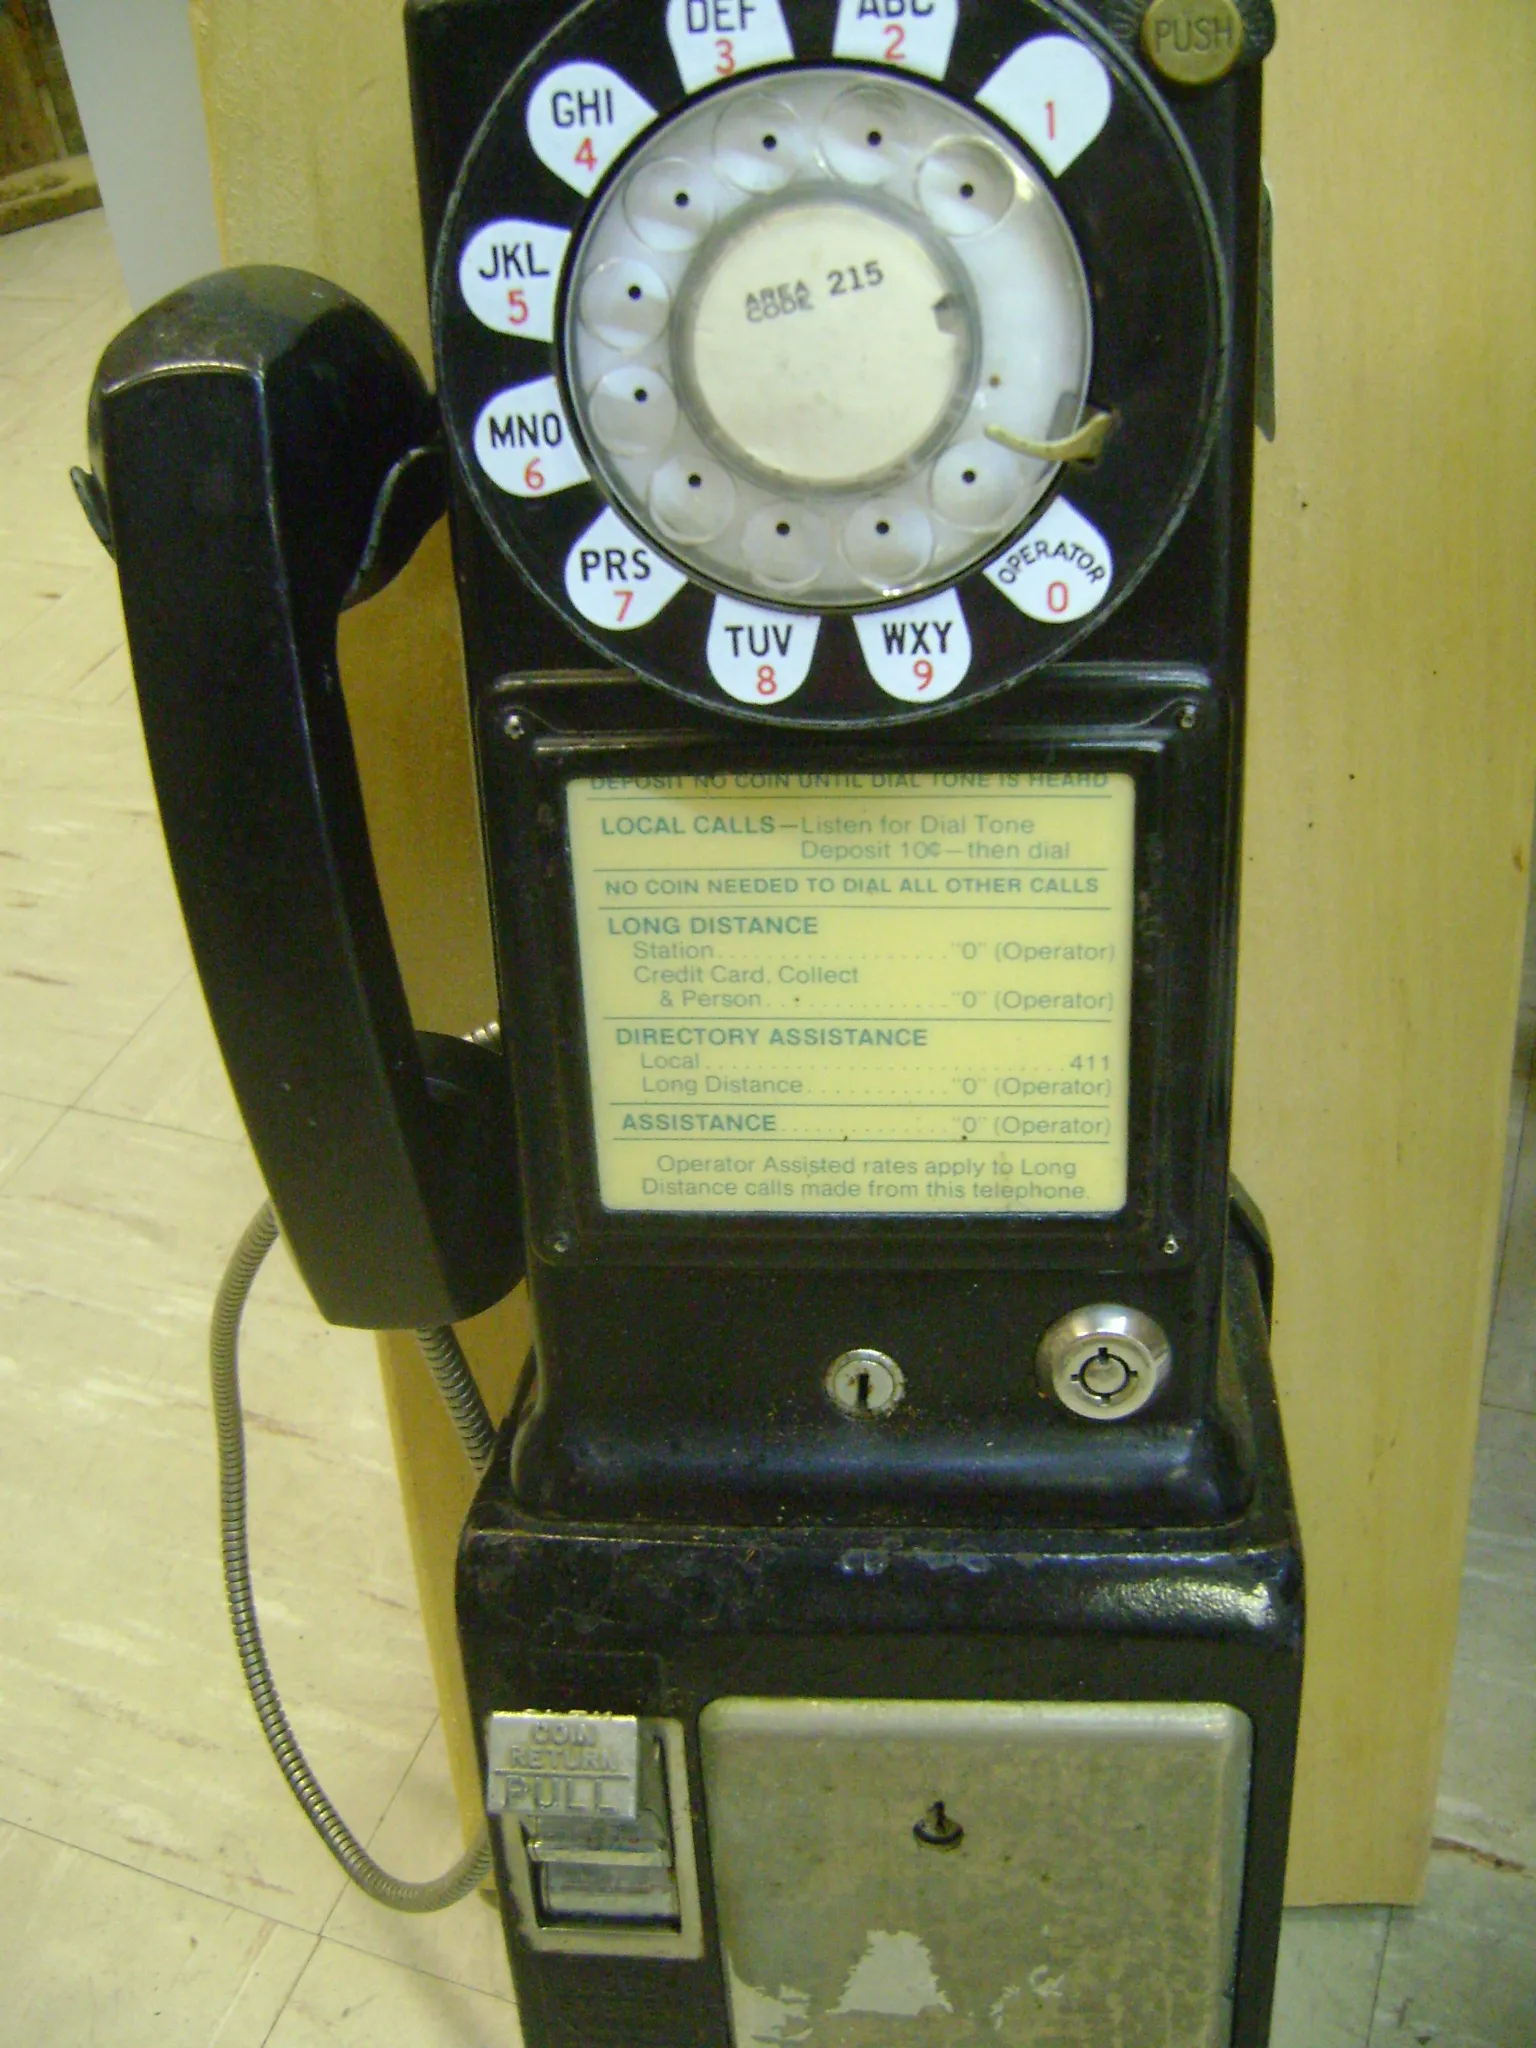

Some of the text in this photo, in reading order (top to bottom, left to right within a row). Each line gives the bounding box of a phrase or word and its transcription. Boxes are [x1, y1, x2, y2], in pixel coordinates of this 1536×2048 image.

[687, 0, 756, 34] DEF
[883, 24, 906, 61] 2
[1154, 15, 1233, 52] PUSH
[714, 39, 735, 77] 3
[551, 89, 614, 129] GHI
[1046, 99, 1055, 141] 1
[574, 137, 597, 172] 4
[478, 242, 550, 281] JKL
[745, 260, 884, 309] AREA 215
[507, 289, 529, 324] 5
[488, 411, 563, 449] MNO
[524, 456, 545, 491] 6
[580, 548, 651, 583] PRS
[998, 540, 1106, 584] OPERATOR
[613, 590, 634, 623] 7
[1047, 581, 1068, 613] 0
[724, 624, 792, 657] TUV
[882, 620, 952, 655] WXY
[756, 664, 777, 696] 8
[912, 659, 934, 691] 9
[590, 774, 1108, 790] DEPOSIT NO COIN UNTIL DIAL TONE IS HEARD
[600, 816, 685, 835] LOCAL
[880, 816, 911, 834] for
[921, 815, 967, 834] Dial
[974, 814, 1035, 834] Tone
[801, 840, 891, 862] Deposit
[1028, 842, 1070, 859] dial
[605, 878, 1099, 895] NO COIN NEEDED TO DIAL ALL OTHER CALLS
[608, 916, 819, 935] LONG DISTANCE
[633, 941, 715, 959] Station
[994, 941, 1115, 963] (Operator)
[634, 966, 704, 984] Credit
[779, 966, 859, 984] Collect
[660, 991, 673, 1008] &
[683, 990, 761, 1008] Person
[994, 990, 1114, 1012] (Operator)
[616, 1028, 928, 1046] DIRECTORY ASSISTANCE
[640, 1053, 1110, 1071] Local 411
[642, 1076, 698, 1095] Long
[705, 1076, 803, 1094] Distance
[994, 1077, 1112, 1098] (Operator)
[622, 1114, 777, 1132] ASSISTANCE
[994, 1116, 1111, 1137] (Operator)
[657, 1155, 1076, 1179] Operator Assisted rates apply to Long
[642, 1178, 737, 1195] Distance
[745, 1179, 794, 1197] calls
[801, 1180, 861, 1197] made
[869, 1180, 918, 1198] from
[926, 1181, 965, 1198] this
[532, 1721, 597, 1746] COIN
[510, 1745, 619, 1771] RETURN
[505, 1775, 616, 1814] PULL
